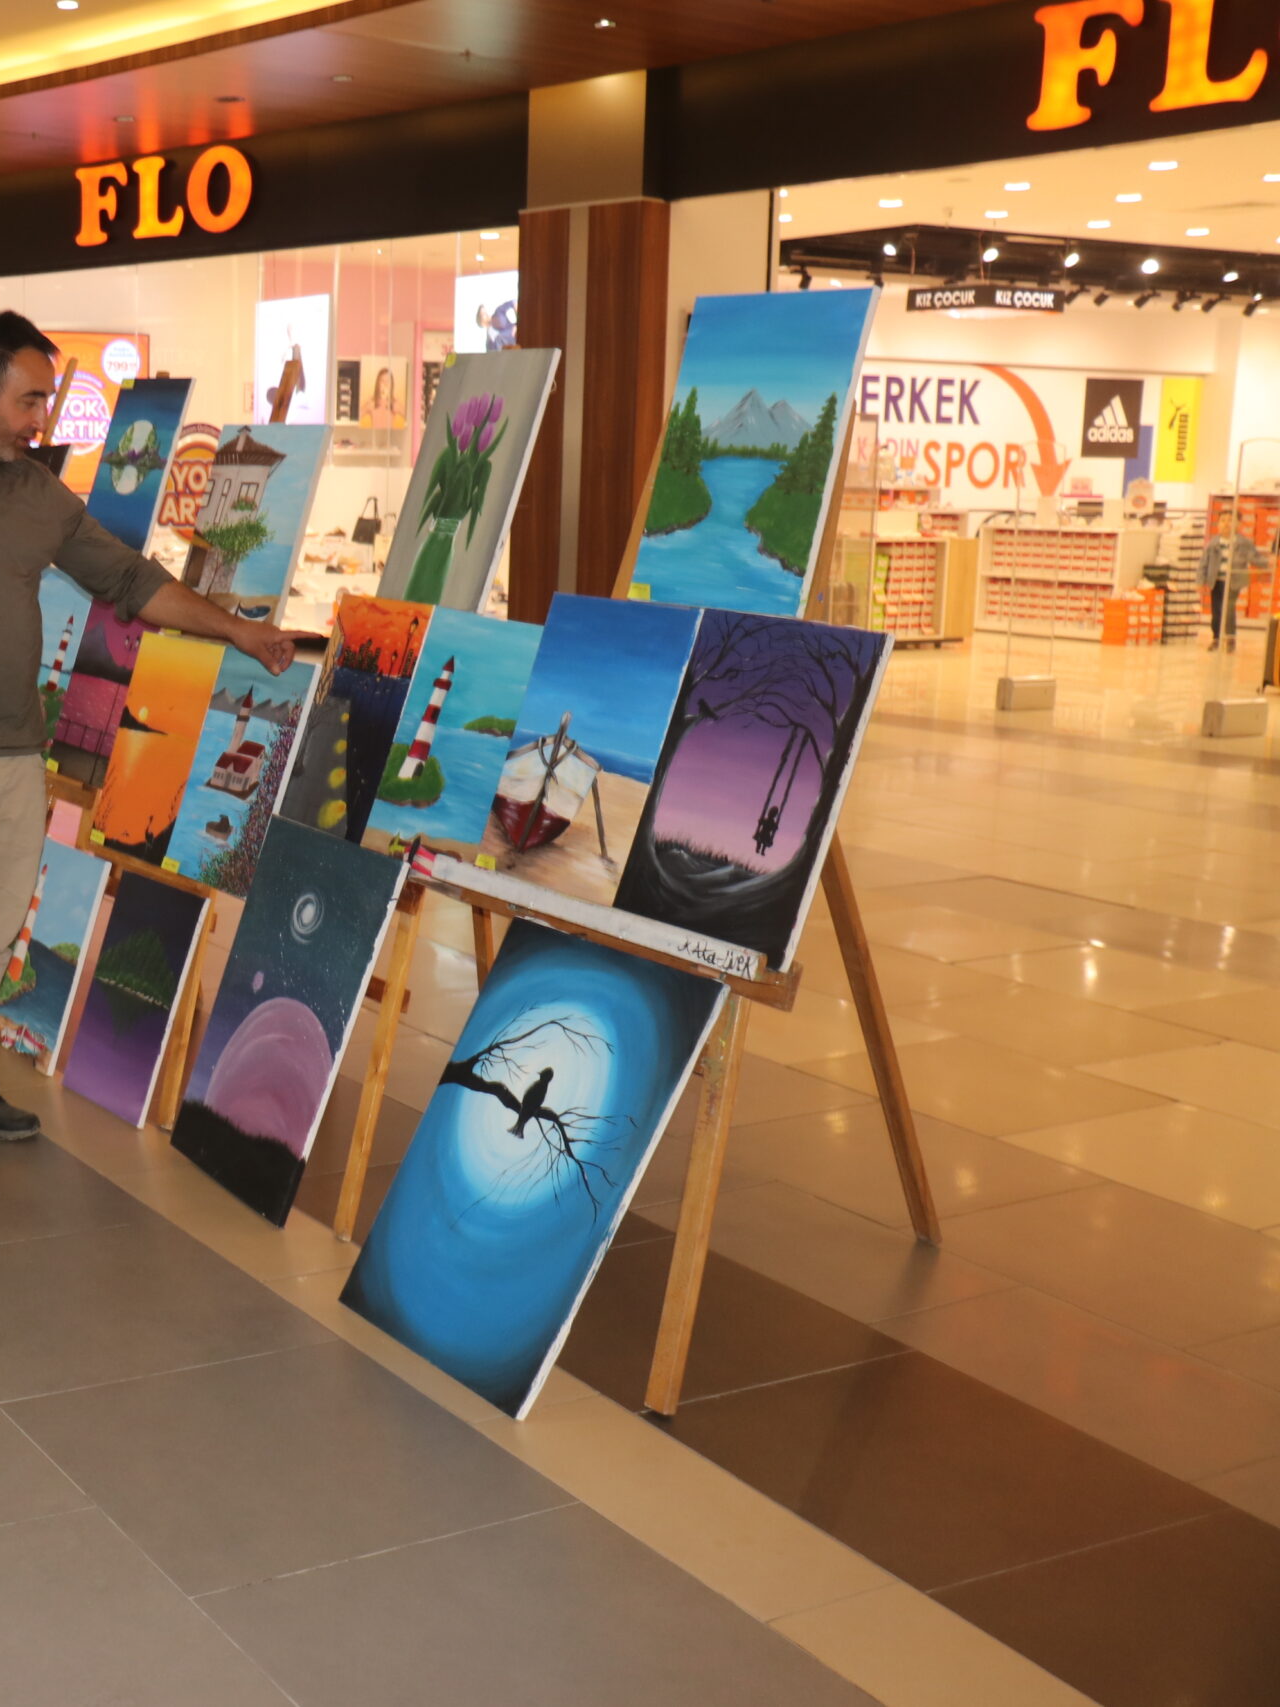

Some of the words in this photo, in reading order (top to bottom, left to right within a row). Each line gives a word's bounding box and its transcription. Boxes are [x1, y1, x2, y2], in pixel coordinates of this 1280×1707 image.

[75, 145, 253, 247] FLO
[933, 290, 976, 309] ÇOCUK
[1014, 291, 1055, 309] ÇOCUK
[860, 375, 980, 425] ERKEK
[1087, 424, 1134, 443] adidas
[923, 440, 1026, 489] SPOR
